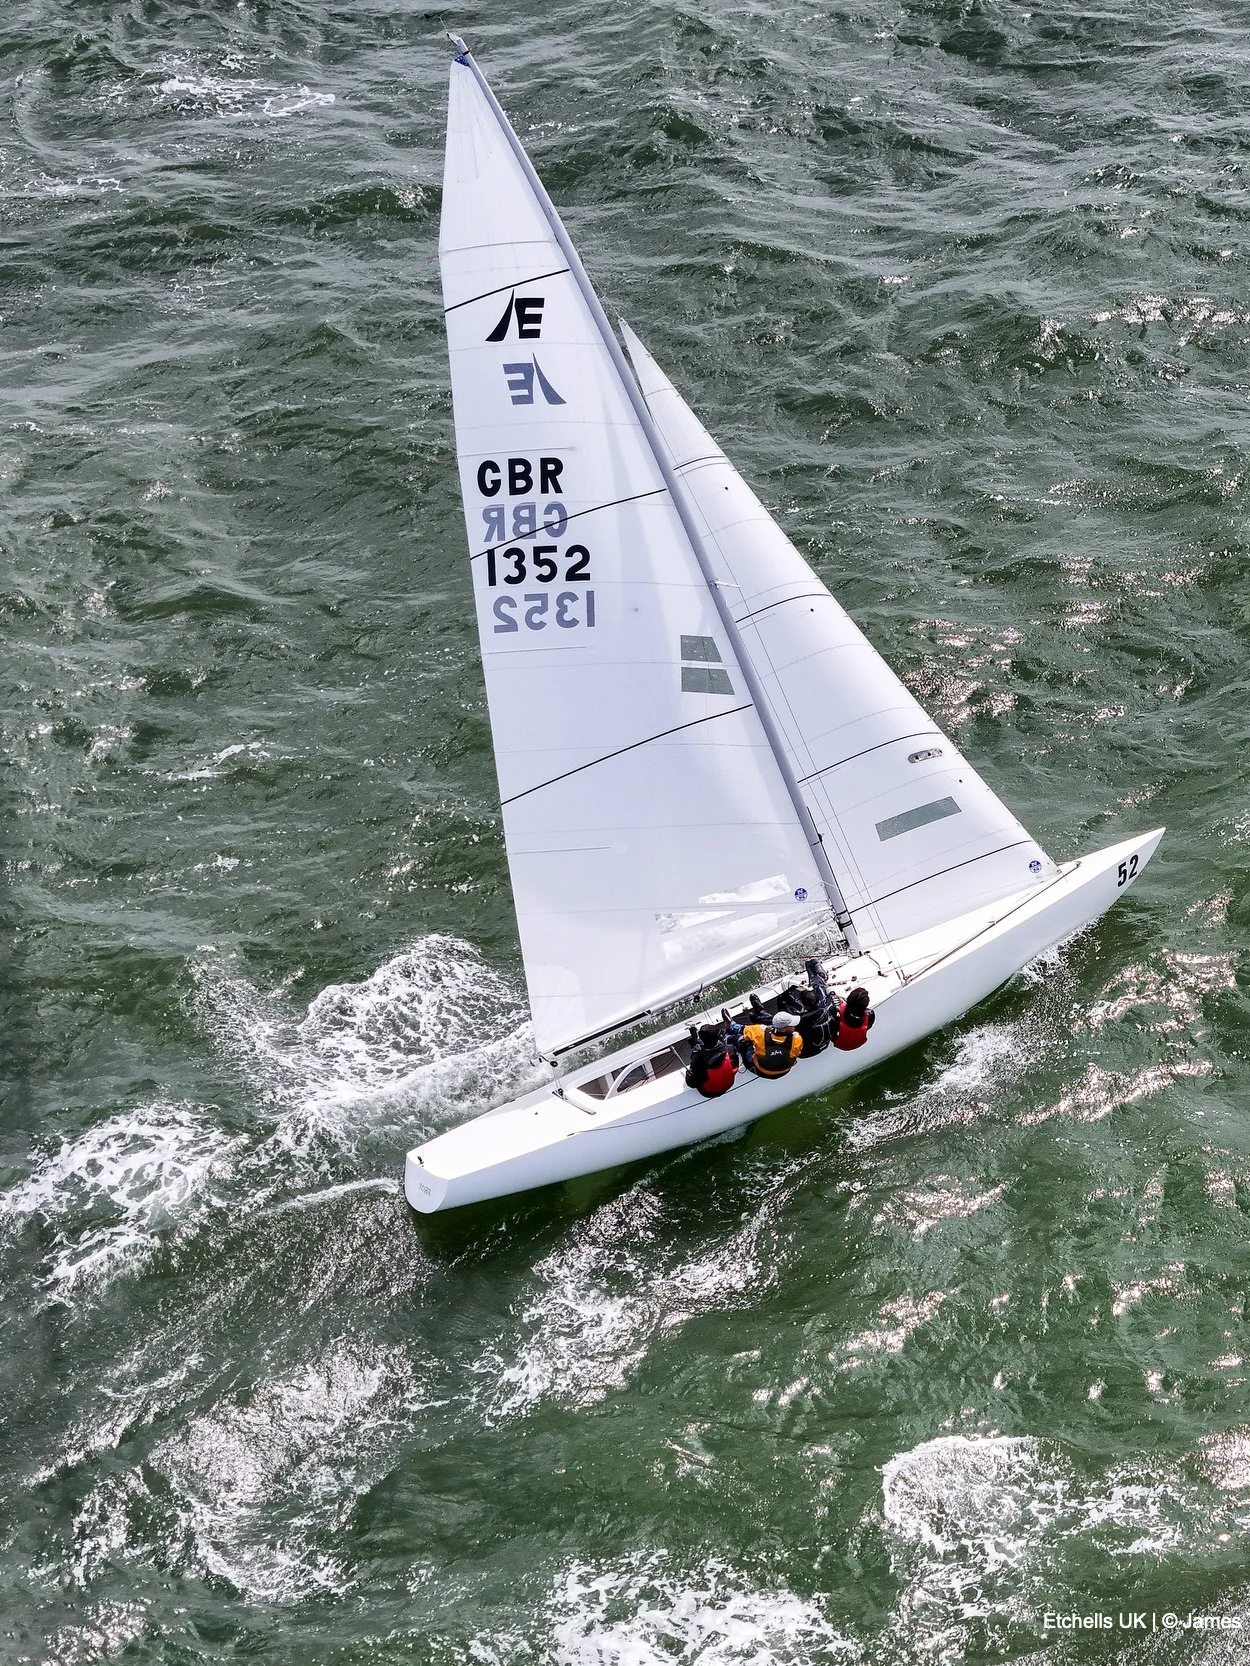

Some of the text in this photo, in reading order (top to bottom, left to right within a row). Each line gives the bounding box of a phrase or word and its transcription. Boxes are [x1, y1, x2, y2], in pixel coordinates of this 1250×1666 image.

[477, 457, 564, 498] GBR
[486, 545, 591, 587] 1352
[1117, 854, 1139, 887] 52
